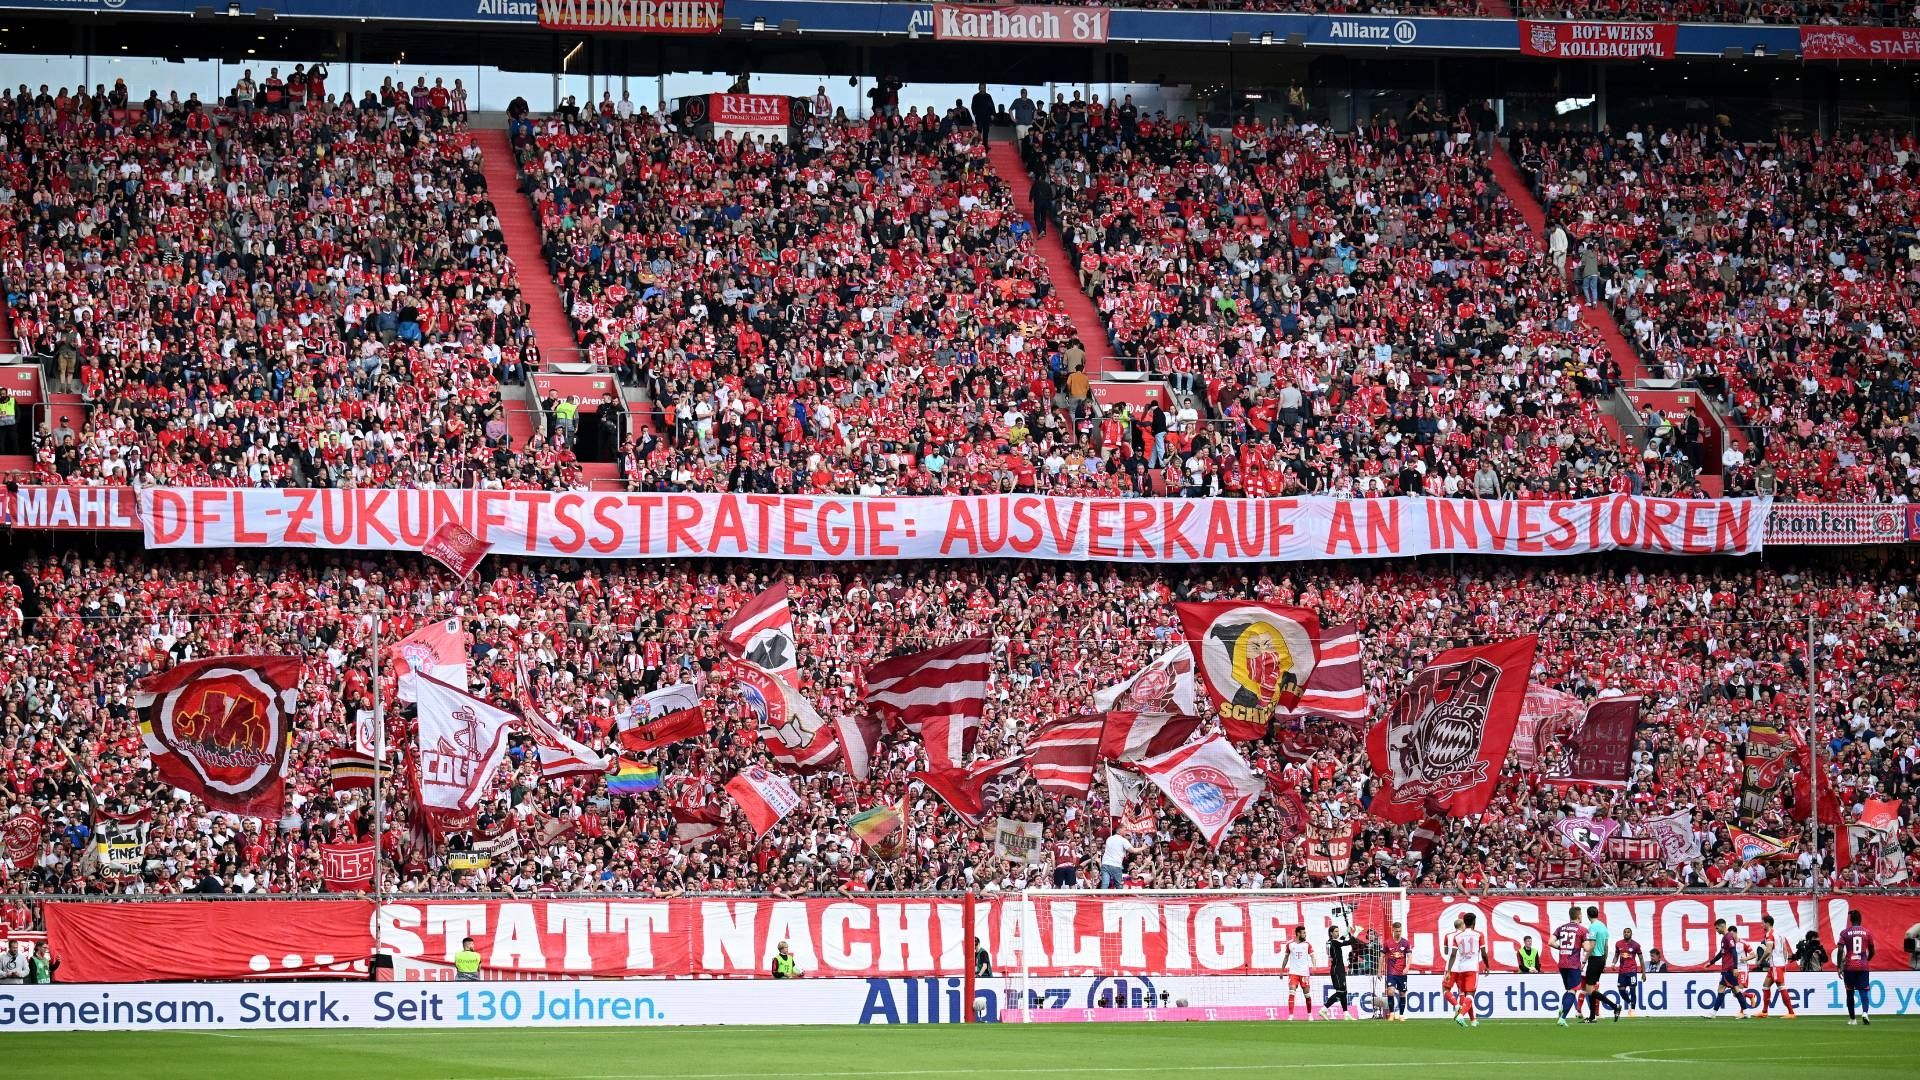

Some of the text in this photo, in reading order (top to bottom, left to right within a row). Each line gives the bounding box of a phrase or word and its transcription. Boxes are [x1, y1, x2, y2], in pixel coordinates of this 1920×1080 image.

[543, 0, 719, 28] WALDKIRCHEN
[942, 8, 1060, 38] Karbach
[1330, 22, 1389, 38] Allianz
[1572, 25, 1653, 40] ROT-WEISS
[1902, 31, 1920, 40] BA
[1560, 42, 1664, 57] KOLLBACHTAL
[722, 95, 780, 114] RHM
[7, 388, 31, 396] Arena
[17, 488, 131, 527] MAHL
[153, 487, 1752, 560] DFL-ZUKUNFTSSTRATEGIE: AUSVERKAUF AN INVESTOREN
[108, 846, 142, 861] EINER
[1057, 845, 1070, 857] 72
[369, 904, 669, 970] STATT
[700, 901, 1356, 971] NACHHALTIGER
[1560, 931, 1576, 949] 23
[1461, 937, 1475, 957] 11
[1852, 937, 1862, 954] 8
[1506, 982, 1560, 1012] the
[0, 988, 665, 1025] Gemeinsam. Stark. Seit 130 Jahren.
